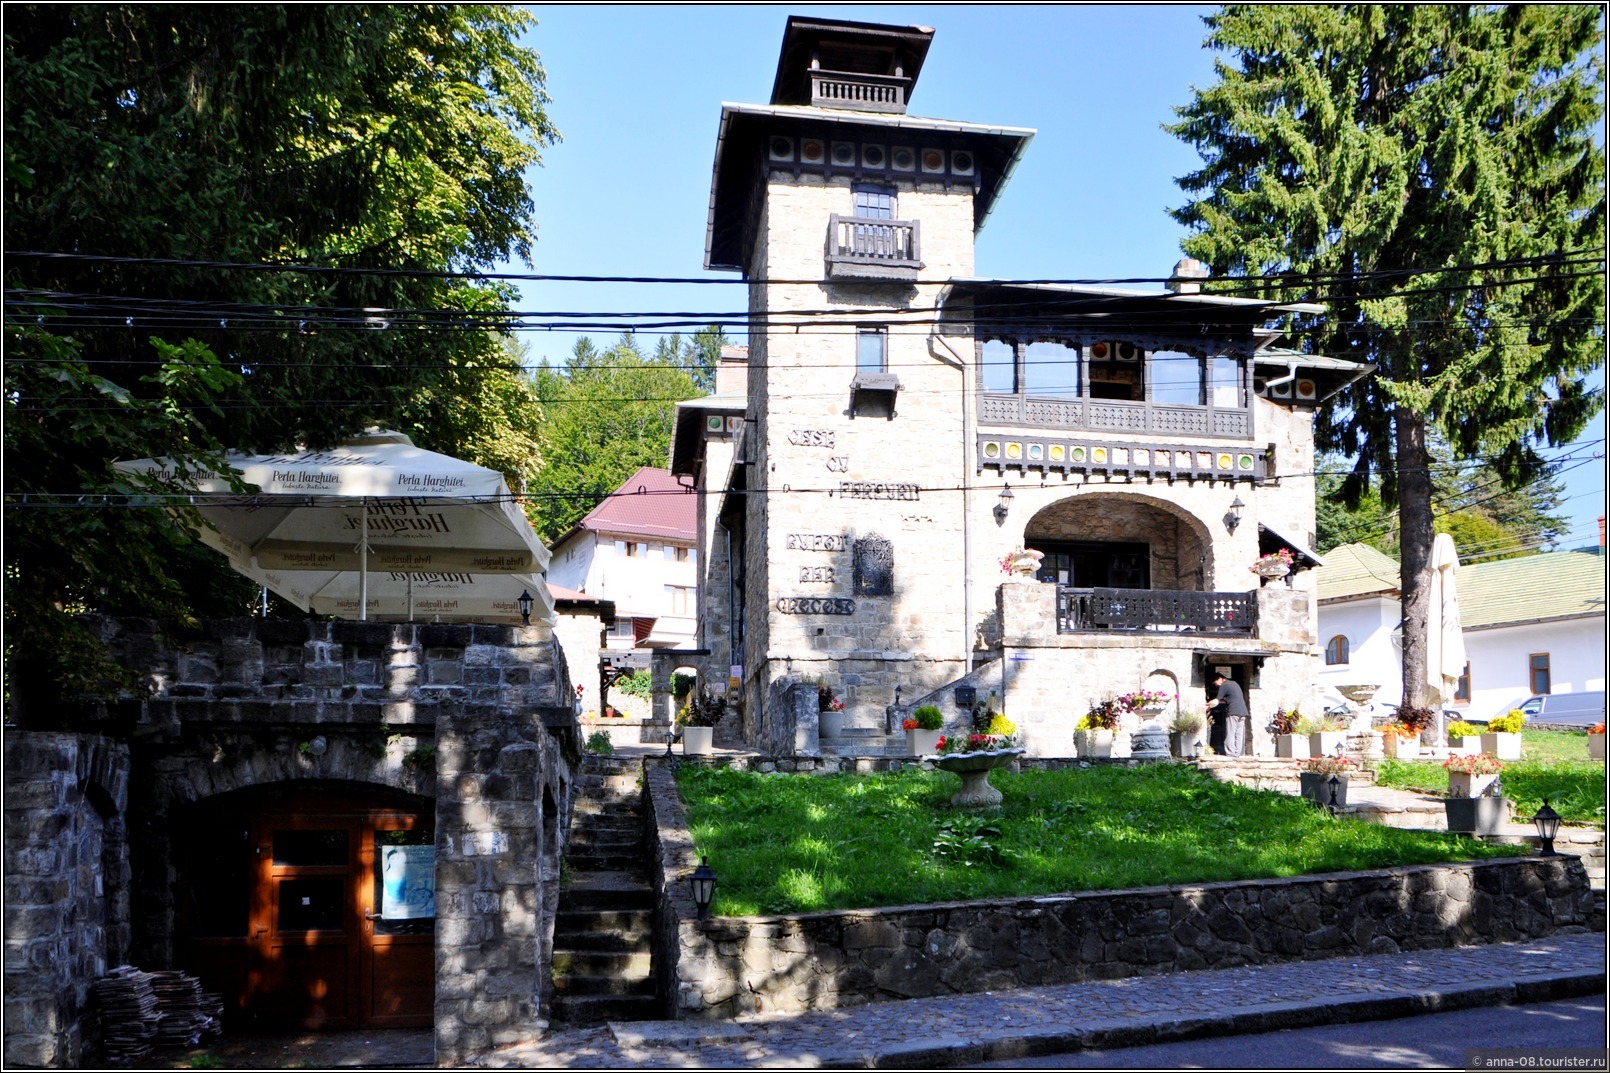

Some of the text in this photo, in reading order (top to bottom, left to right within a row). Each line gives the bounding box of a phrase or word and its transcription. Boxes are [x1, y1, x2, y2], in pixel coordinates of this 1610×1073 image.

[272, 470, 340, 485] Perla Harghitei
[398, 473, 464, 487] Perla Harghitei
